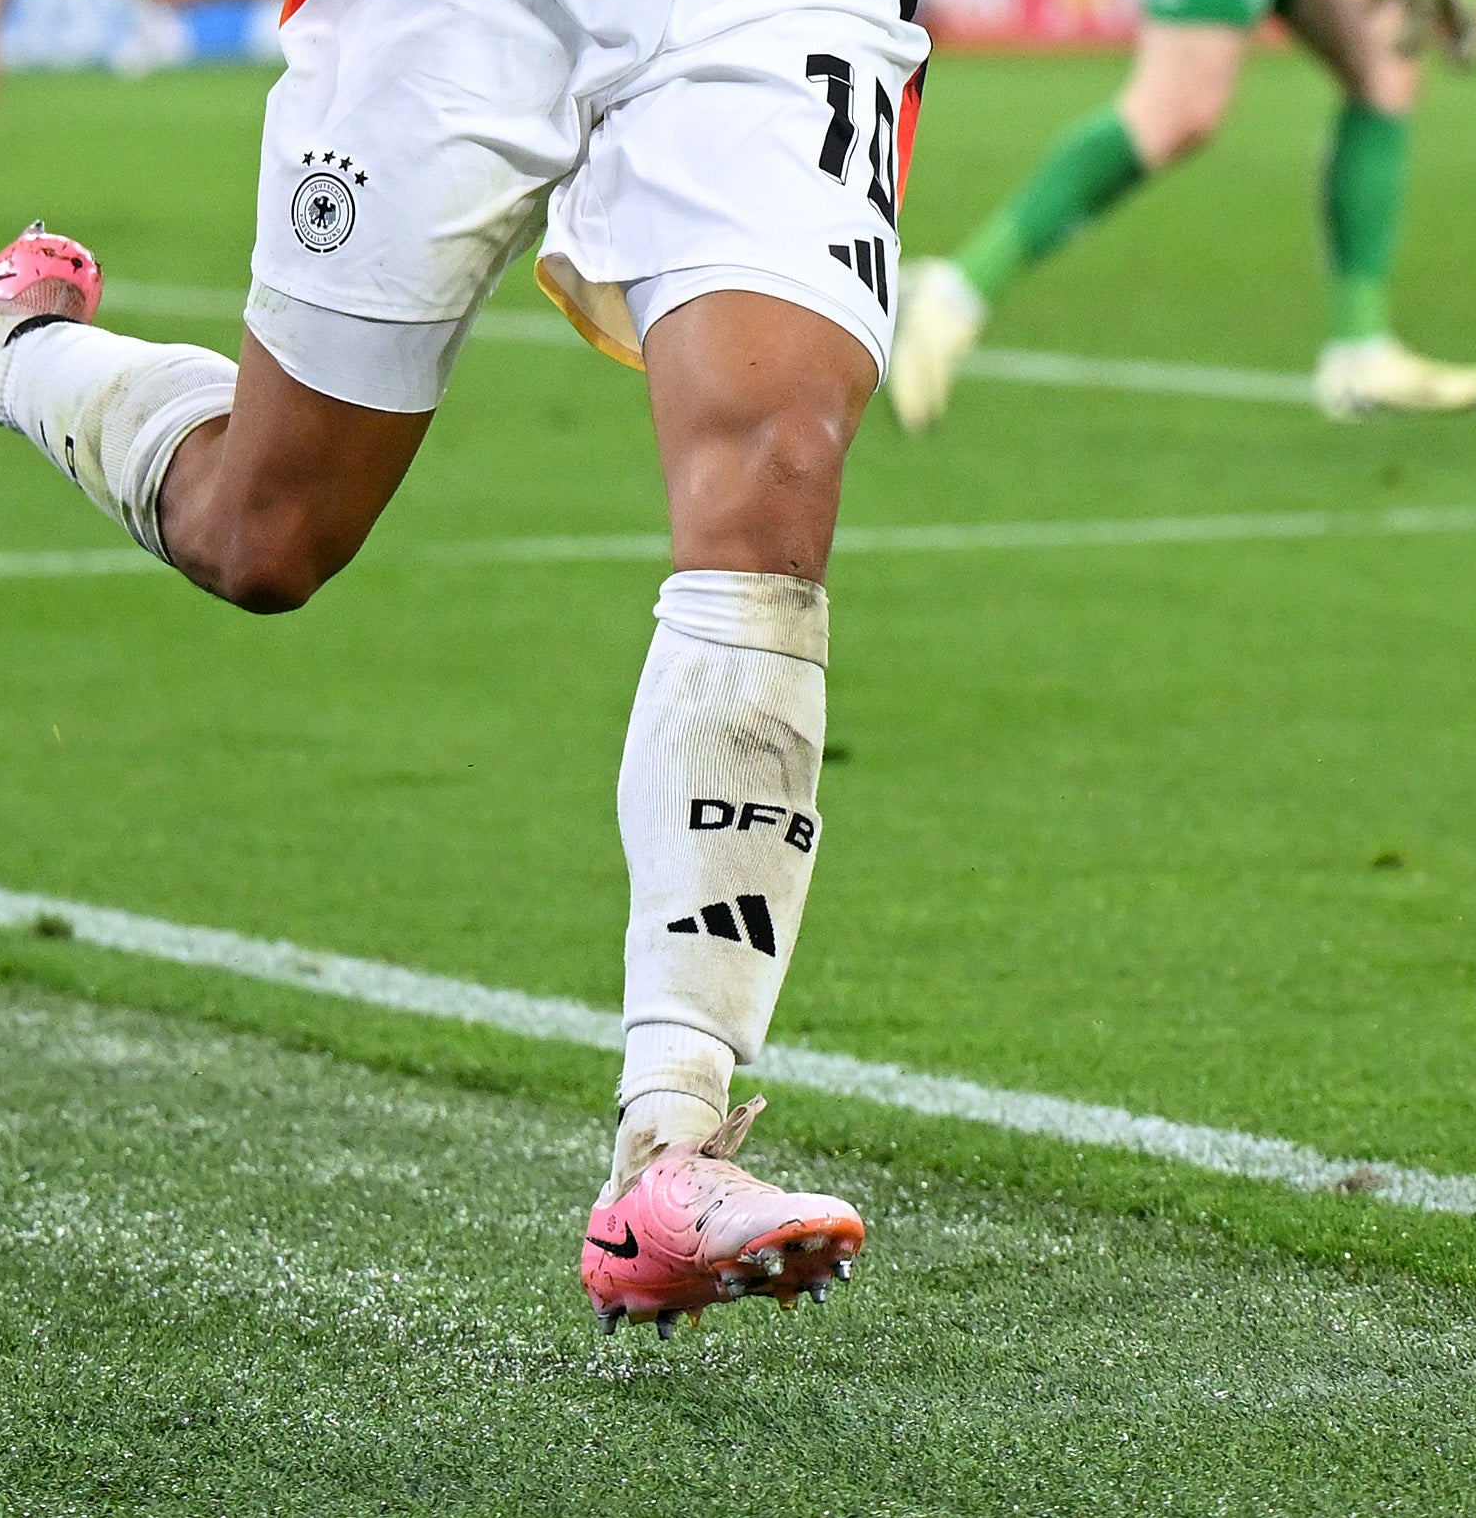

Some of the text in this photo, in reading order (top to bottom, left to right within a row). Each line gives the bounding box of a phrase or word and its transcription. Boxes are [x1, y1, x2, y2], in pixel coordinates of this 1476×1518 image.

[806, 54, 897, 232] 10
[310, 183, 344, 203] DEUTSCHER
[689, 799, 815, 853] DFB
